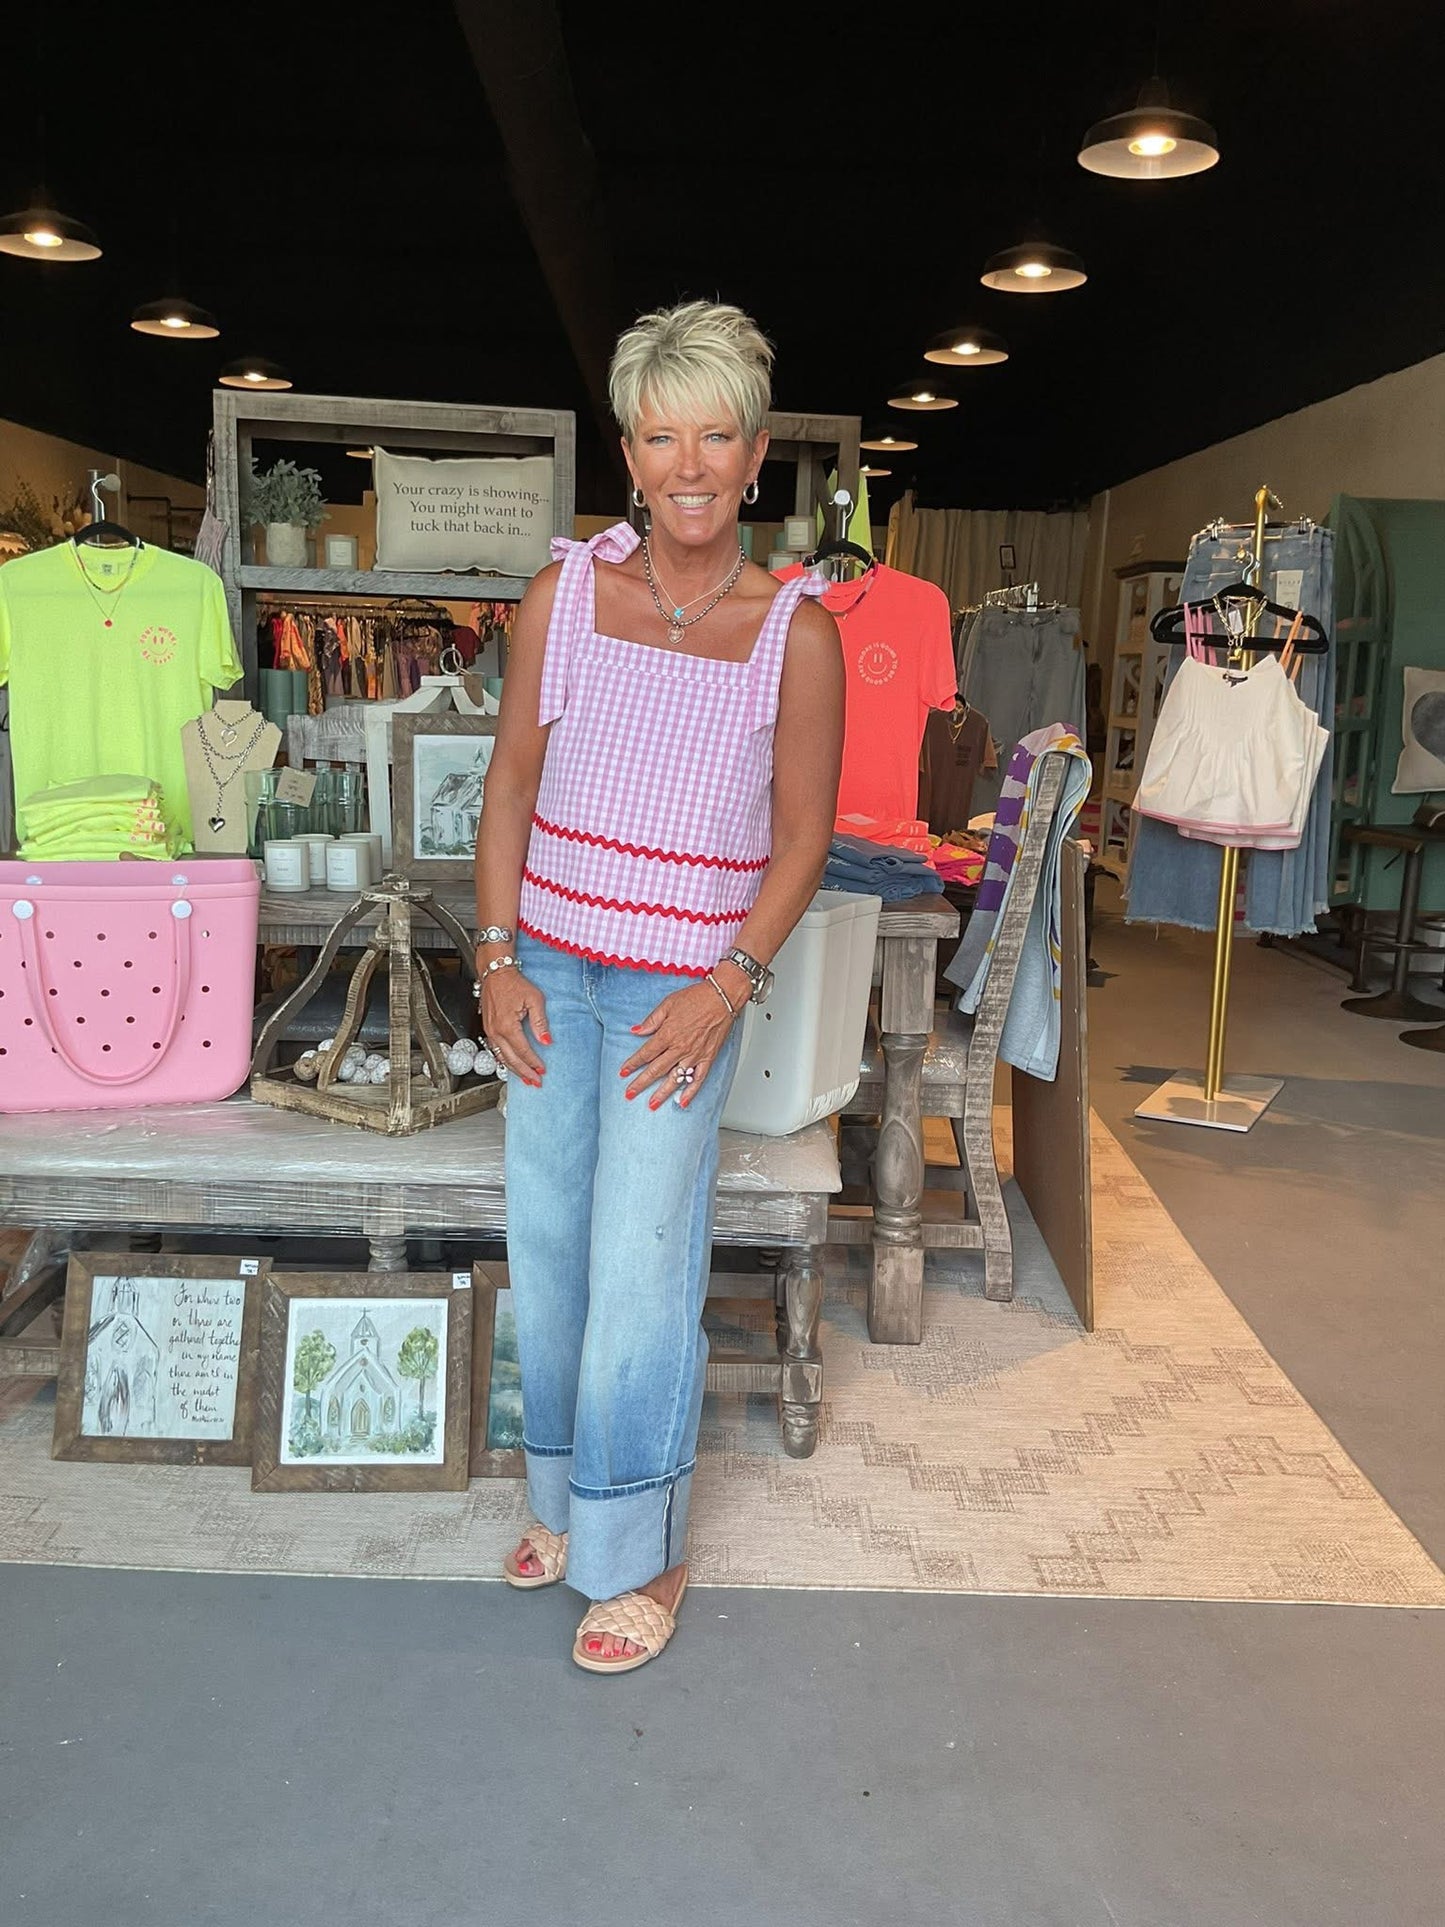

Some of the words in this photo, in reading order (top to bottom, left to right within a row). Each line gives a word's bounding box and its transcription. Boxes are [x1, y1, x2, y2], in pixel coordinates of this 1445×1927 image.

[392, 481, 425, 496] Your
[428, 485, 465, 500] crazy
[469, 484, 480, 497] is
[483, 484, 550, 505] showing...
[410, 500, 436, 514] You
[440, 501, 479, 517] might
[484, 506, 517, 518] want
[520, 506, 533, 519] to
[410, 519, 440, 532] tuck
[444, 520, 470, 533] that
[474, 521, 505, 535] back
[508, 523, 531, 537] in...
[174, 1282, 192, 1307] For
[223, 1289, 241, 1306] two
[172, 1317, 182, 1327] or
[188, 1308, 213, 1327] three
[217, 1318, 233, 1328] are
[168, 1329, 206, 1354] gathered
[169, 1365, 191, 1378] there
[171, 1382, 187, 1397] the
[180, 1400, 189, 1420] of
[194, 1398, 217, 1412] them
